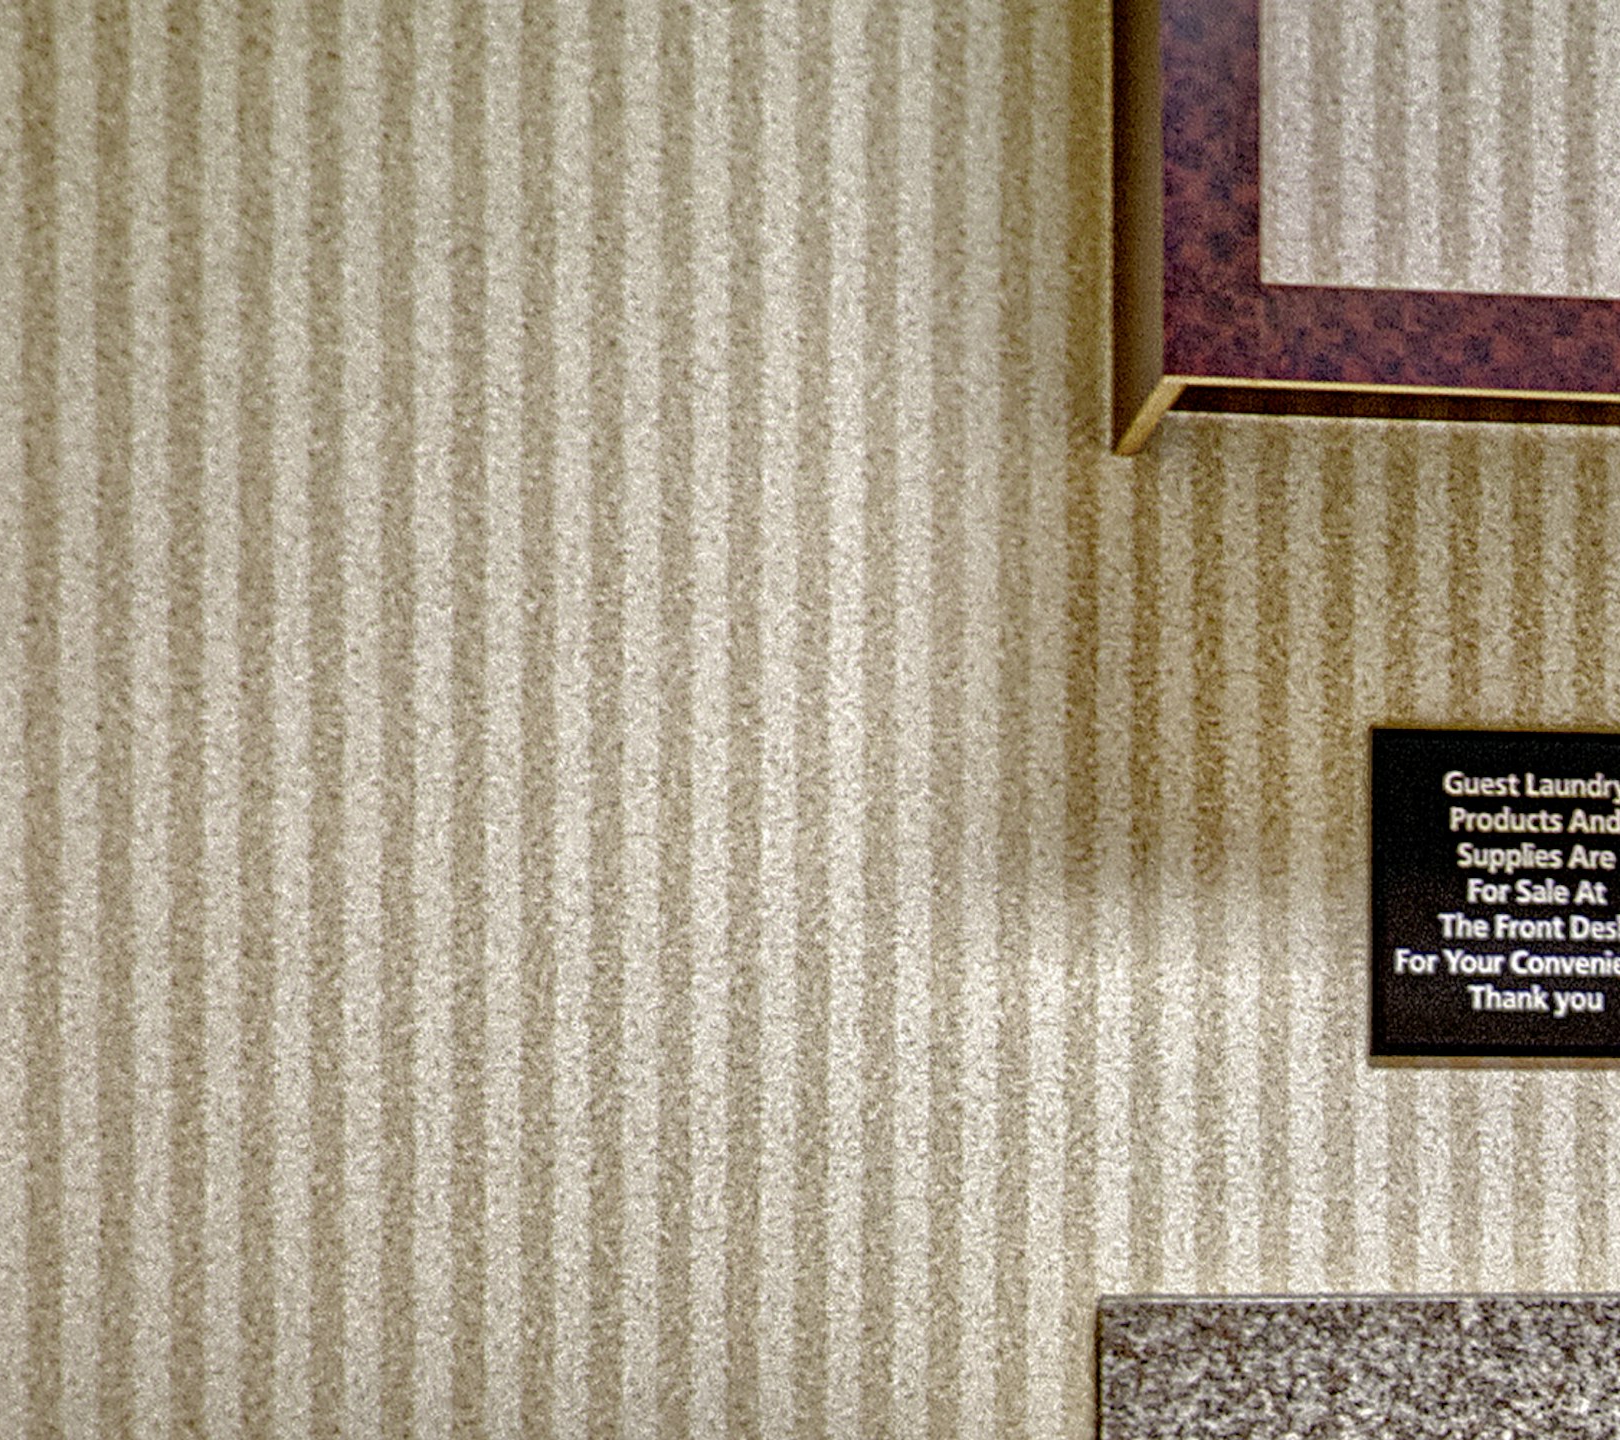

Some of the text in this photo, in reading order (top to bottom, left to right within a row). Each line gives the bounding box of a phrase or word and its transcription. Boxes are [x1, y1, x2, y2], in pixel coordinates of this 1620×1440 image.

[1442, 770, 1521, 797] Guest
[1448, 806, 1564, 833] Products
[1457, 842, 1617, 875] Supplies Are
[1467, 878, 1609, 906] For Sale At
[1437, 912, 1489, 940] The
[1493, 914, 1566, 940] Front
[1393, 948, 1440, 976] For
[1442, 949, 1506, 976] Your
[1467, 983, 1605, 1018] Thank you
